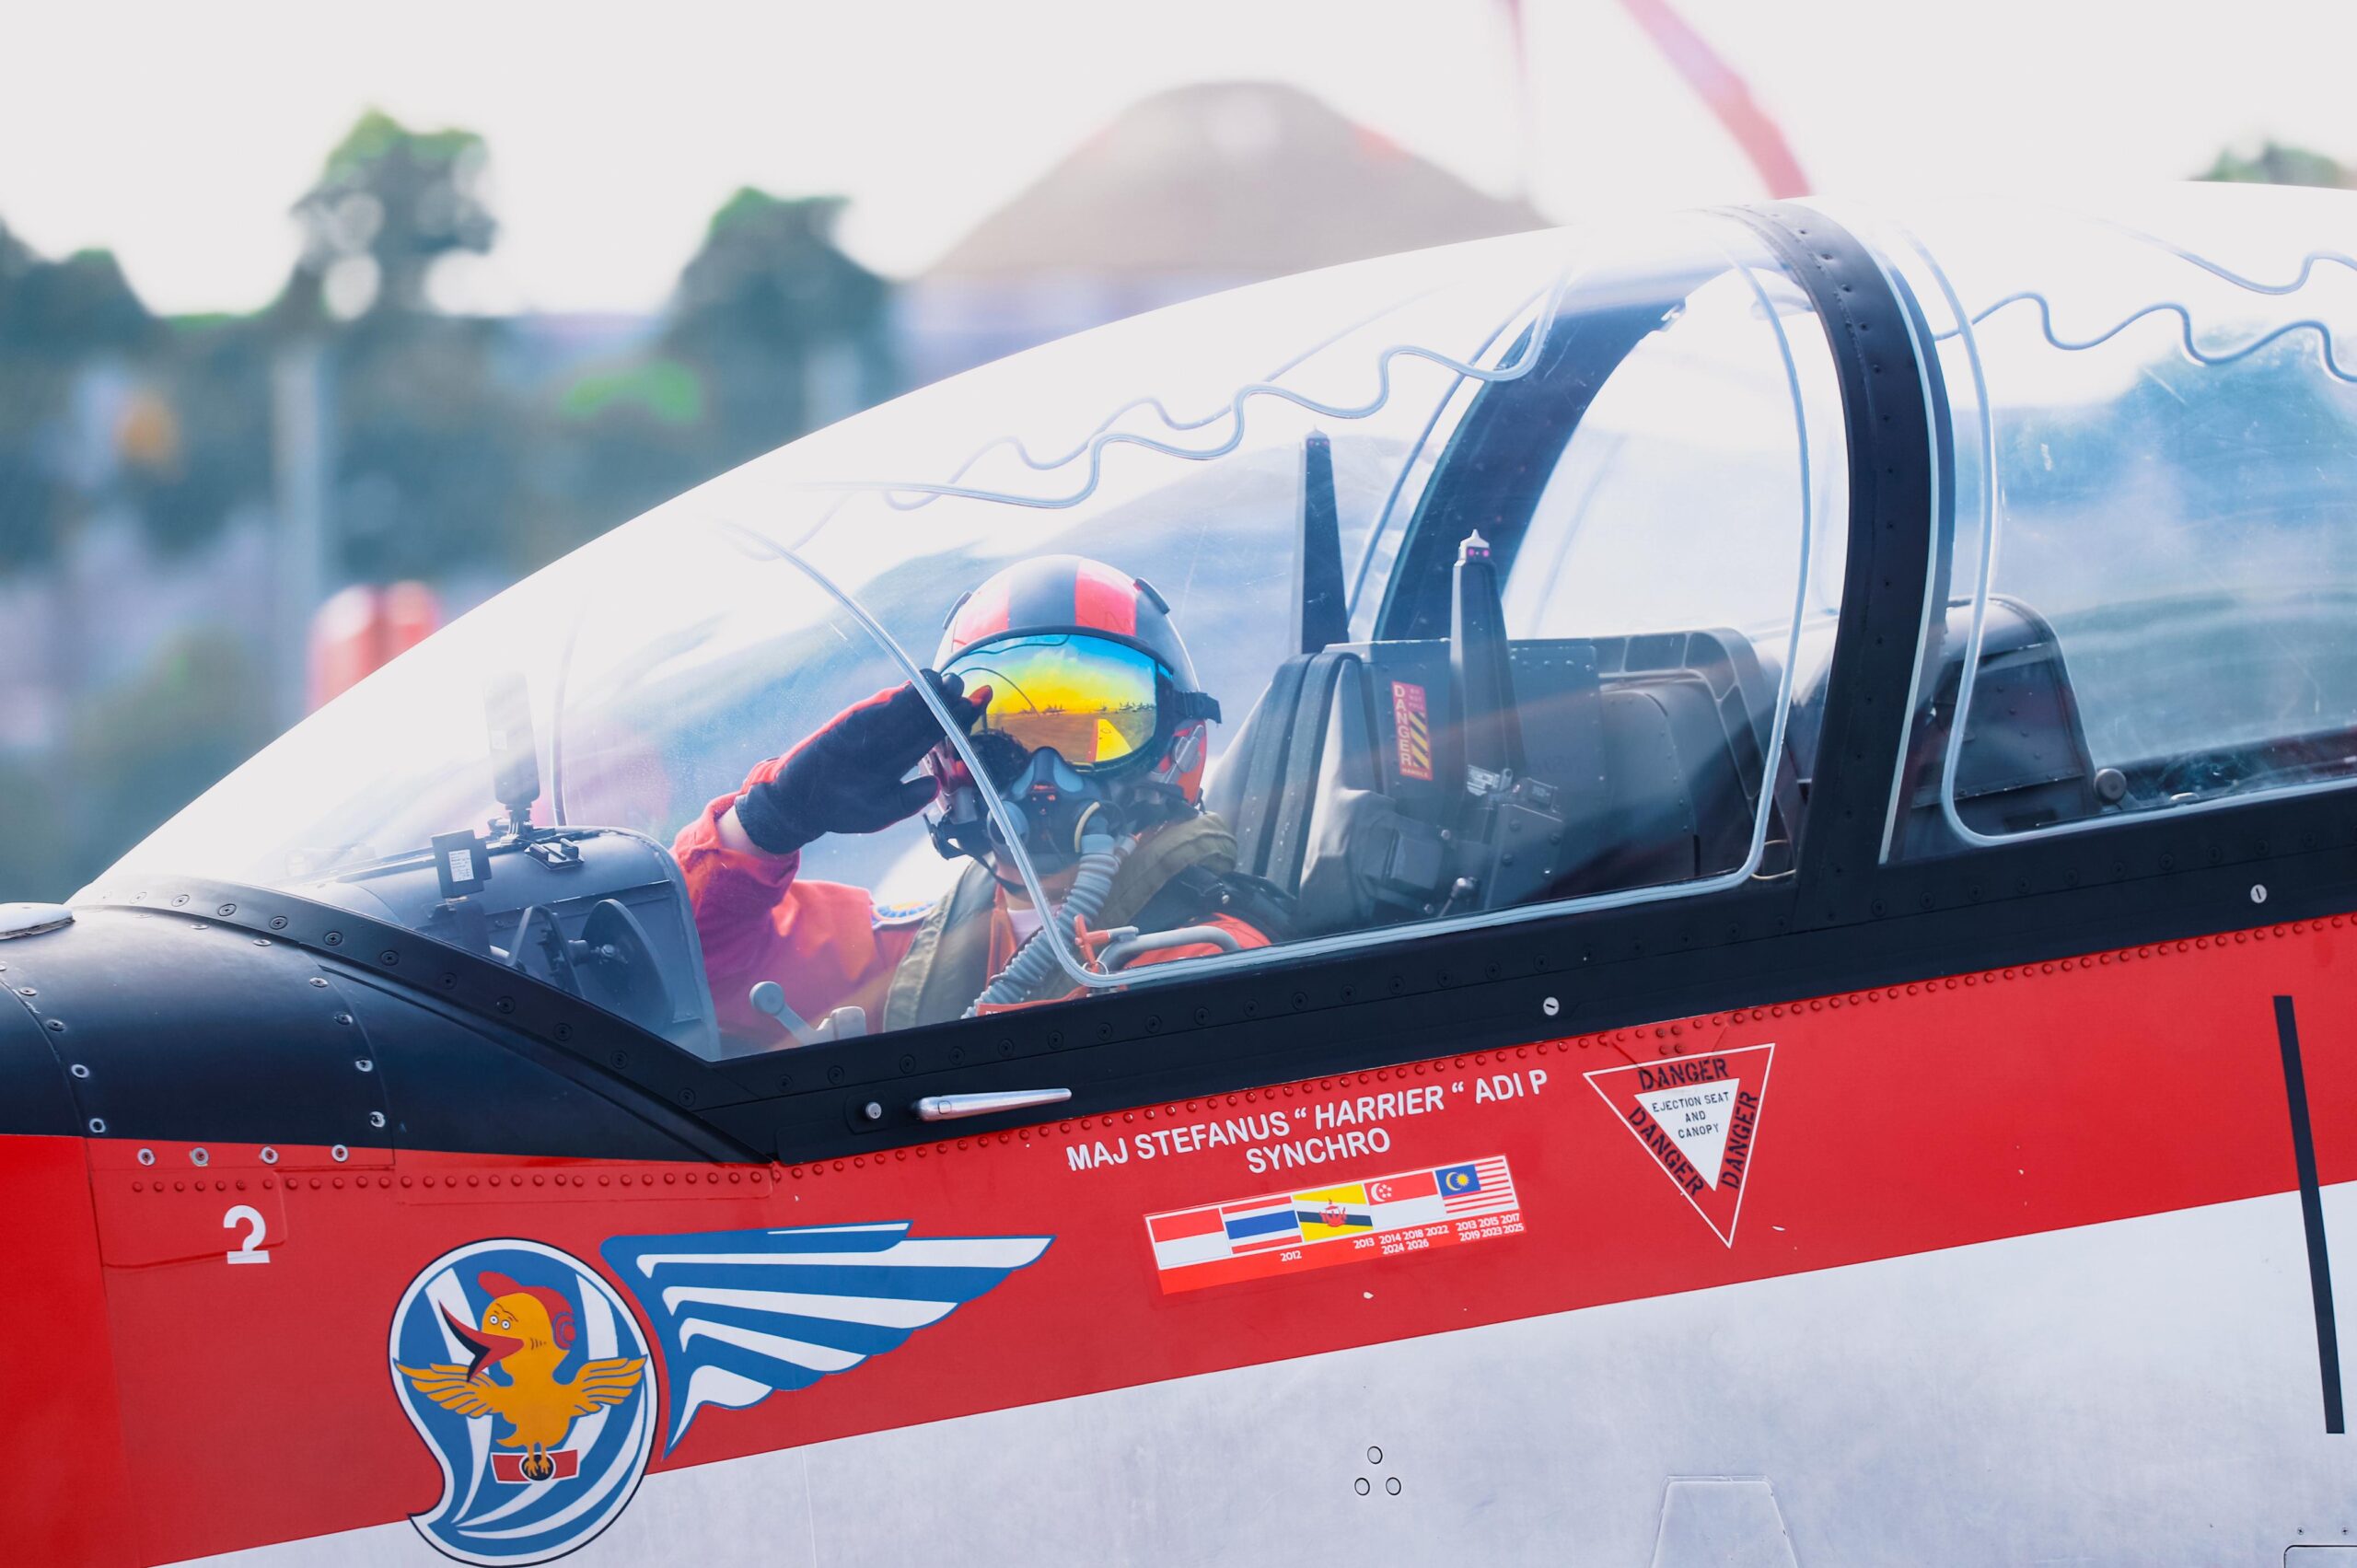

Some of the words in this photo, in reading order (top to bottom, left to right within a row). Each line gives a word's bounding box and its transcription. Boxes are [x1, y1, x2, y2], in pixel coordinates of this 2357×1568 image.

[1393, 684, 1412, 767] DANGER
[1638, 1058, 1729, 1090] DANGER
[1652, 1096, 1701, 1112] EJECTION
[1703, 1091, 1729, 1105] SEAT
[1065, 1137, 1129, 1171] MAJ
[1134, 1111, 1290, 1159] STEFANUS
[1315, 1085, 1445, 1130] HARRIER
[1475, 1072, 1524, 1104] ADI
[1528, 1069, 1548, 1095] P
[1685, 1110, 1706, 1123] AND
[1678, 1123, 1720, 1139] CANOPY
[1721, 1091, 1758, 1189] DANGER
[1246, 1127, 1390, 1173] SYNCHRO
[1628, 1107, 1704, 1195] DANGER
[1456, 1220, 1478, 1231] 2013
[1478, 1216, 1499, 1227] 2015
[1500, 1213, 1520, 1224] 2017
[223, 1204, 271, 1264] 2
[1378, 1233, 1401, 1245] 2014
[1403, 1229, 1423, 1241] 2018
[1425, 1225, 1449, 1237] 2022
[1458, 1230, 1480, 1242] 2019
[1480, 1226, 1503, 1237] 2023
[1503, 1223, 1525, 1234] 2025
[1353, 1237, 1375, 1249] 2013
[1381, 1243, 1404, 1255] 2024
[1406, 1238, 1429, 1250] 2026
[1280, 1250, 1303, 1262] 2012
